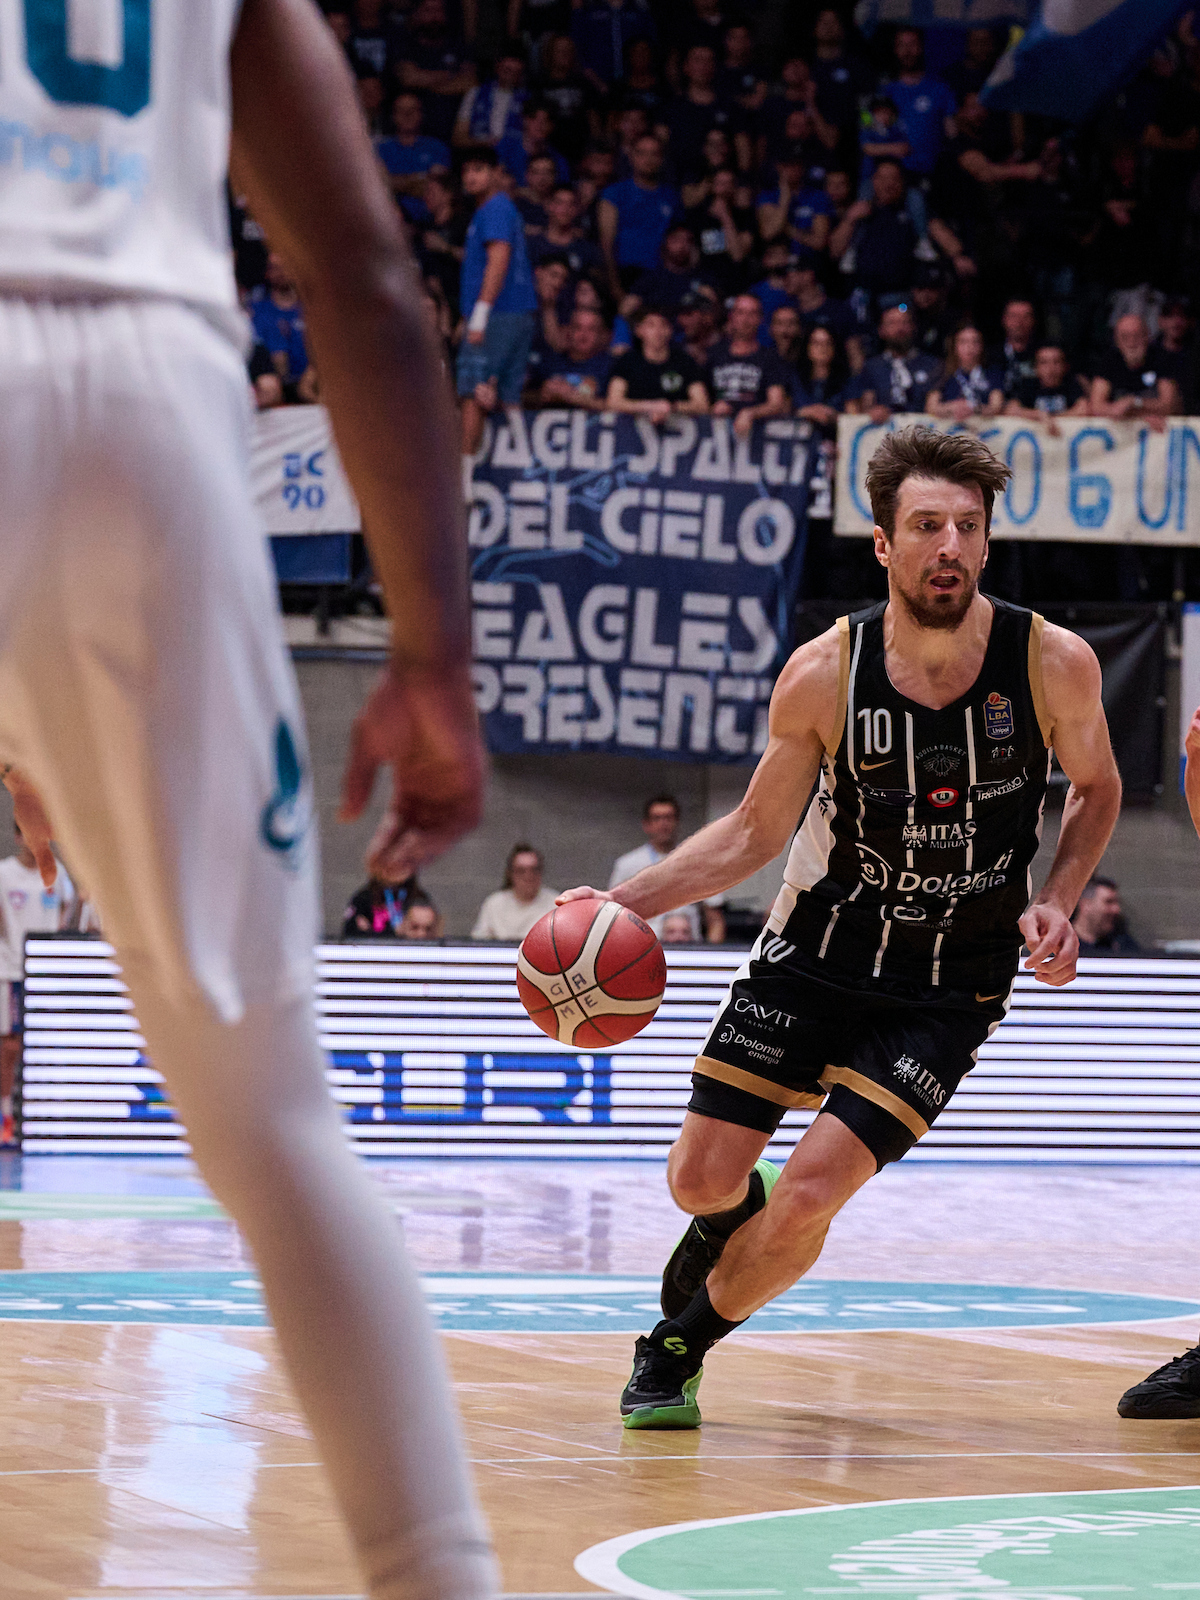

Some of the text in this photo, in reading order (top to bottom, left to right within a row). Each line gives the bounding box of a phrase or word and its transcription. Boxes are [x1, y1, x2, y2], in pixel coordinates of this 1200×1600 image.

[469, 480, 796, 565] DEL CIELO
[472, 583, 778, 674] EAGLES
[988, 711, 1010, 721] LBA
[857, 708, 892, 755] 10
[929, 821, 978, 840] ITAS
[929, 839, 966, 849] MUTUA
[734, 998, 798, 1028] CAVIT
[734, 1034, 785, 1059] Dolomiti
[748, 1050, 780, 1065] energia
[916, 1068, 947, 1106] ITAS
